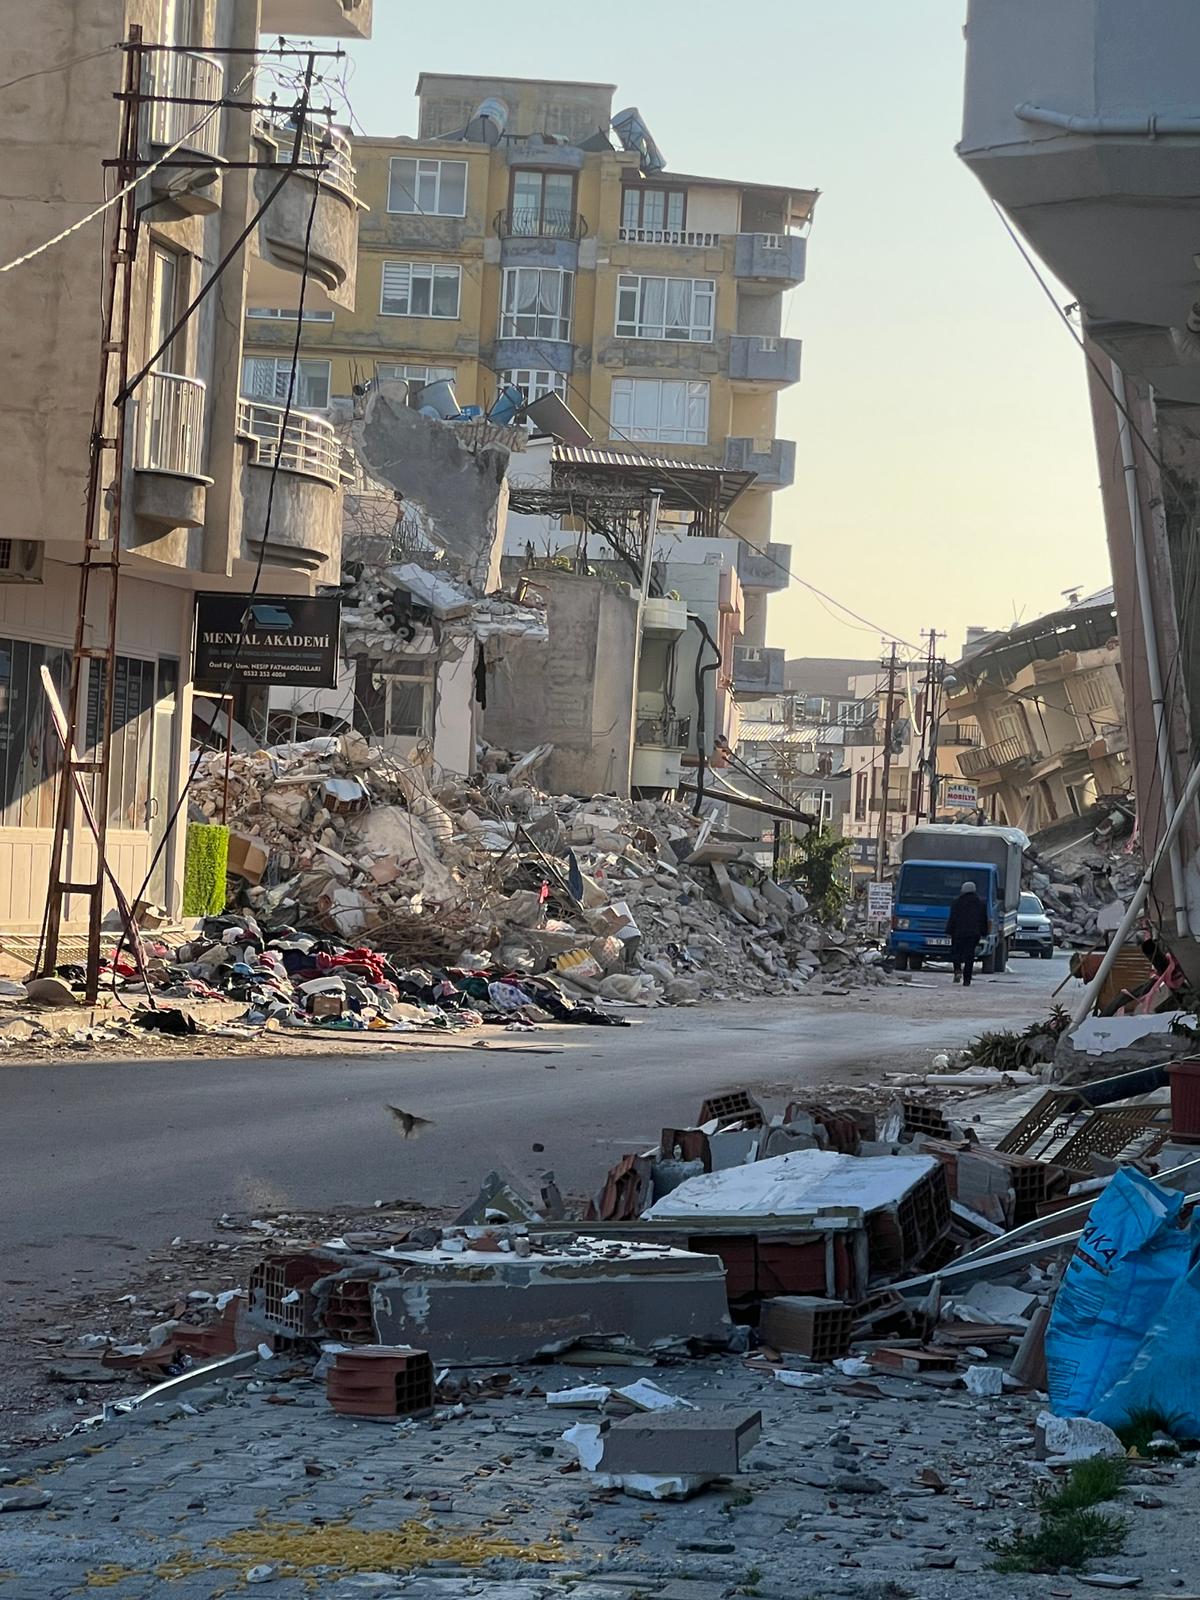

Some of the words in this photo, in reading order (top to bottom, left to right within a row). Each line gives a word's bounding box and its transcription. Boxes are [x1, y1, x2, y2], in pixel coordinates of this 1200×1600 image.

[203, 632, 260, 645] MENTAL
[264, 634, 329, 648] AKADEMİ
[948, 785, 976, 794] MERT
[947, 793, 976, 801] MOBİLYA
